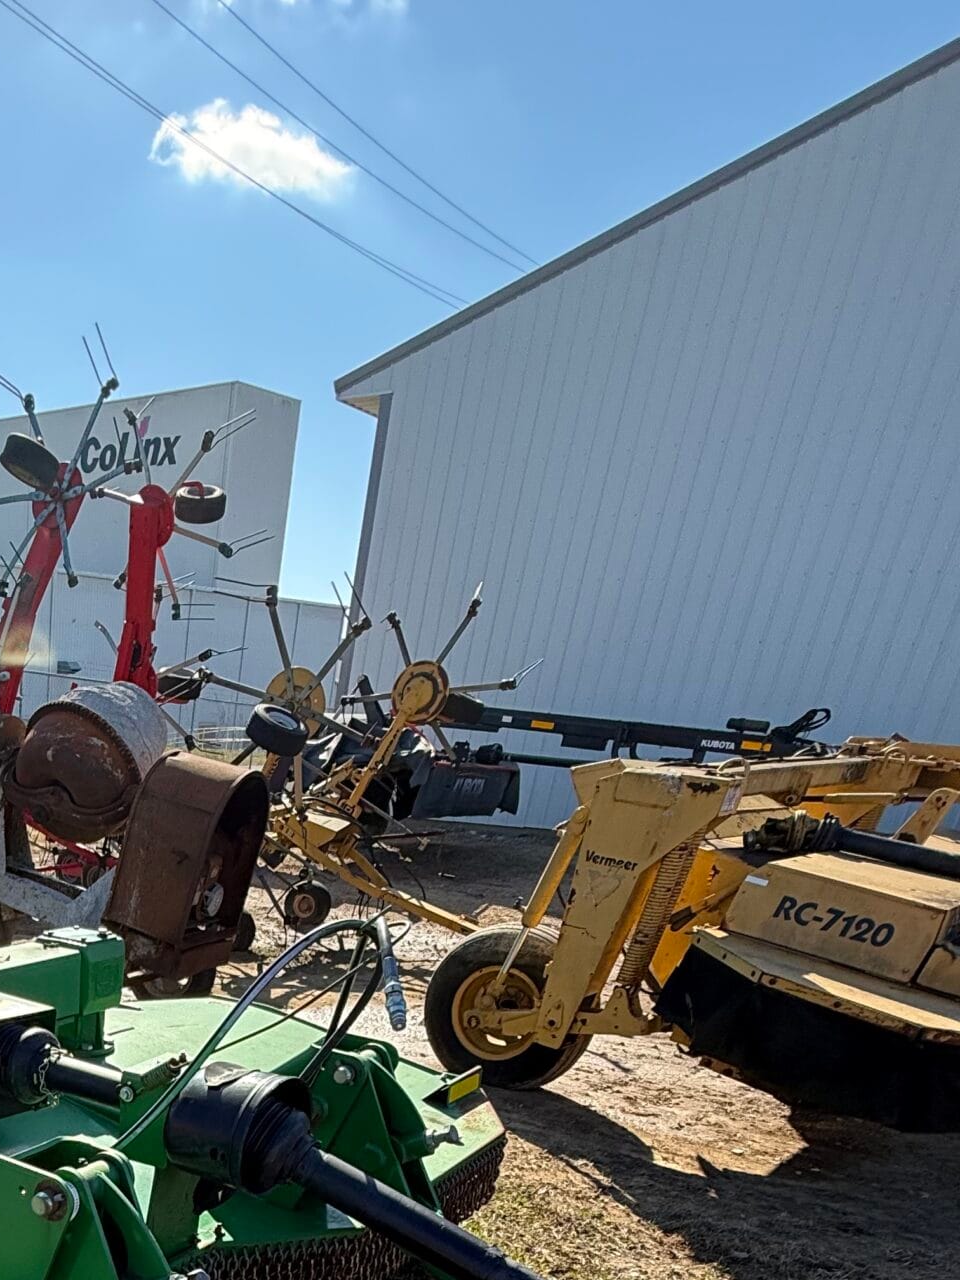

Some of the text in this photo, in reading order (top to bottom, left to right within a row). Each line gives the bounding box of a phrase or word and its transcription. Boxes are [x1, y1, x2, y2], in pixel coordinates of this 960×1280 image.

[700, 739, 735, 751] KUBOTA
[585, 849, 639, 872] Vermeer
[772, 895, 896, 948] RC-7120
